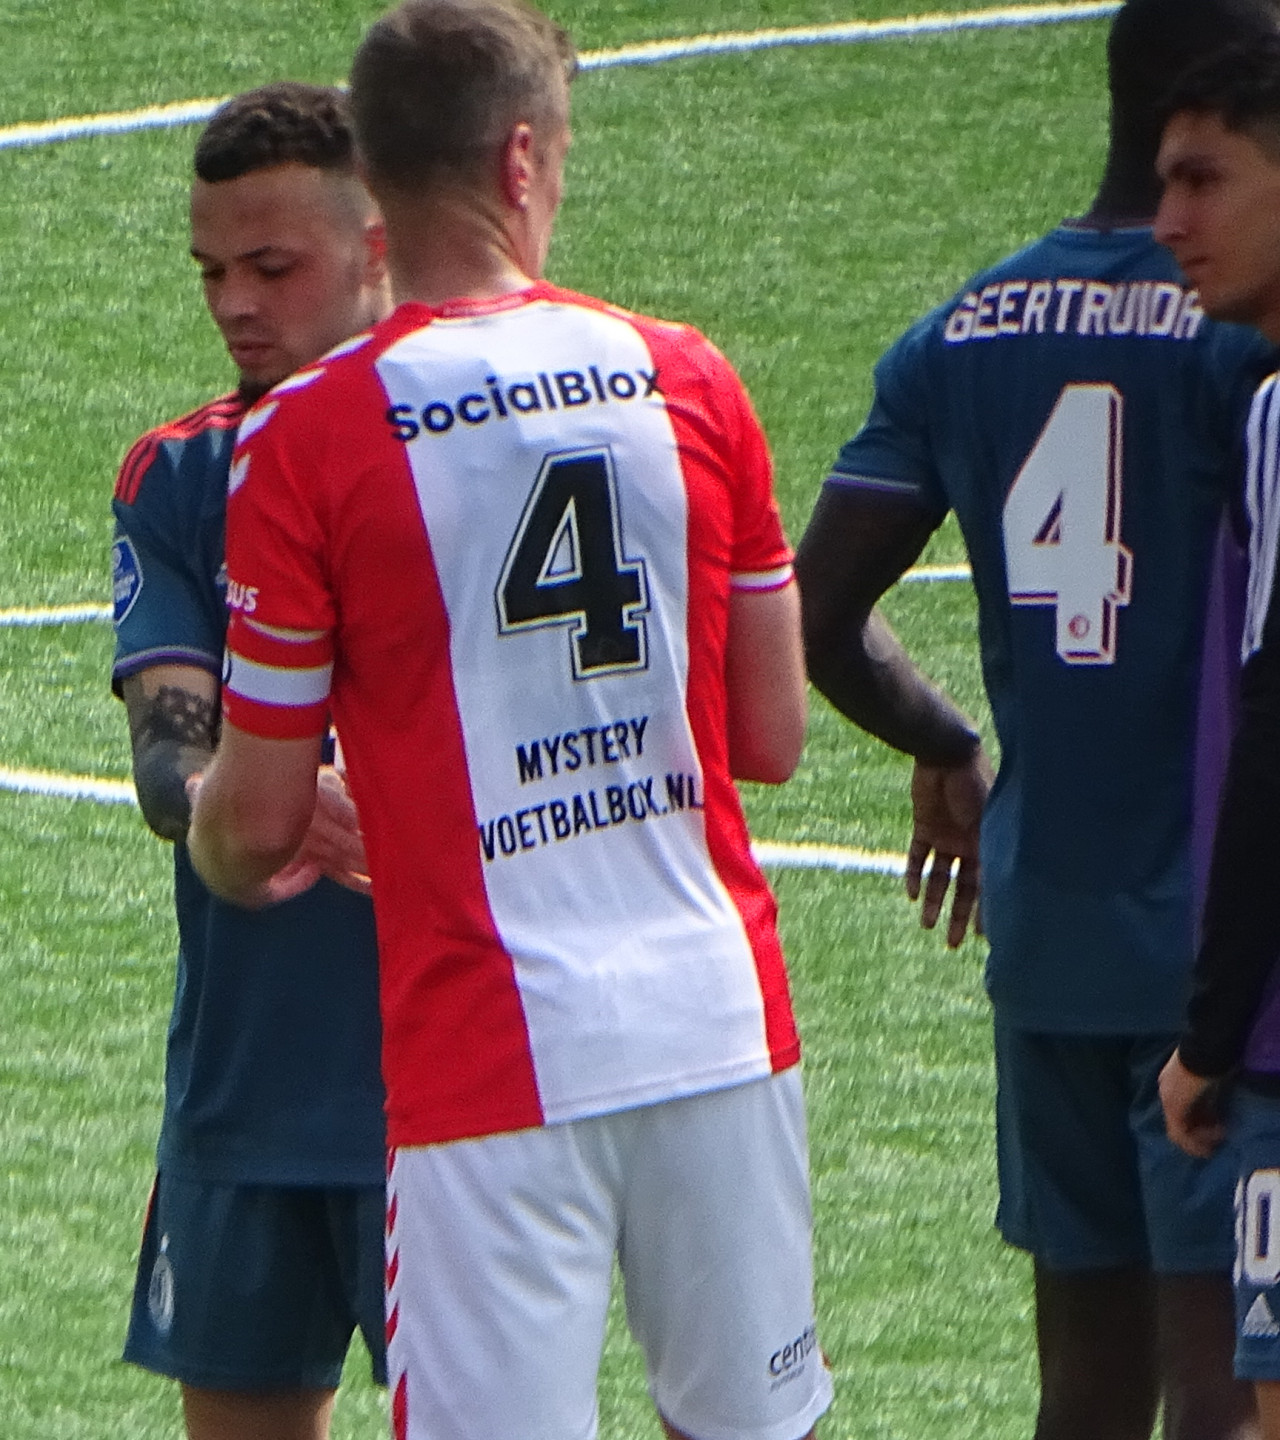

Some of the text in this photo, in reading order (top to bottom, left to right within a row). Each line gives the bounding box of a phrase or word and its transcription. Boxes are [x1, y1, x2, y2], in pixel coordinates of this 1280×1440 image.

[386, 365, 664, 441] SocialBlox
[494, 444, 649, 682] 4
[1003, 380, 1133, 664] 4
[515, 715, 649, 785] MYSTERY
[479, 772, 705, 862] VOETBALBOX.NL
